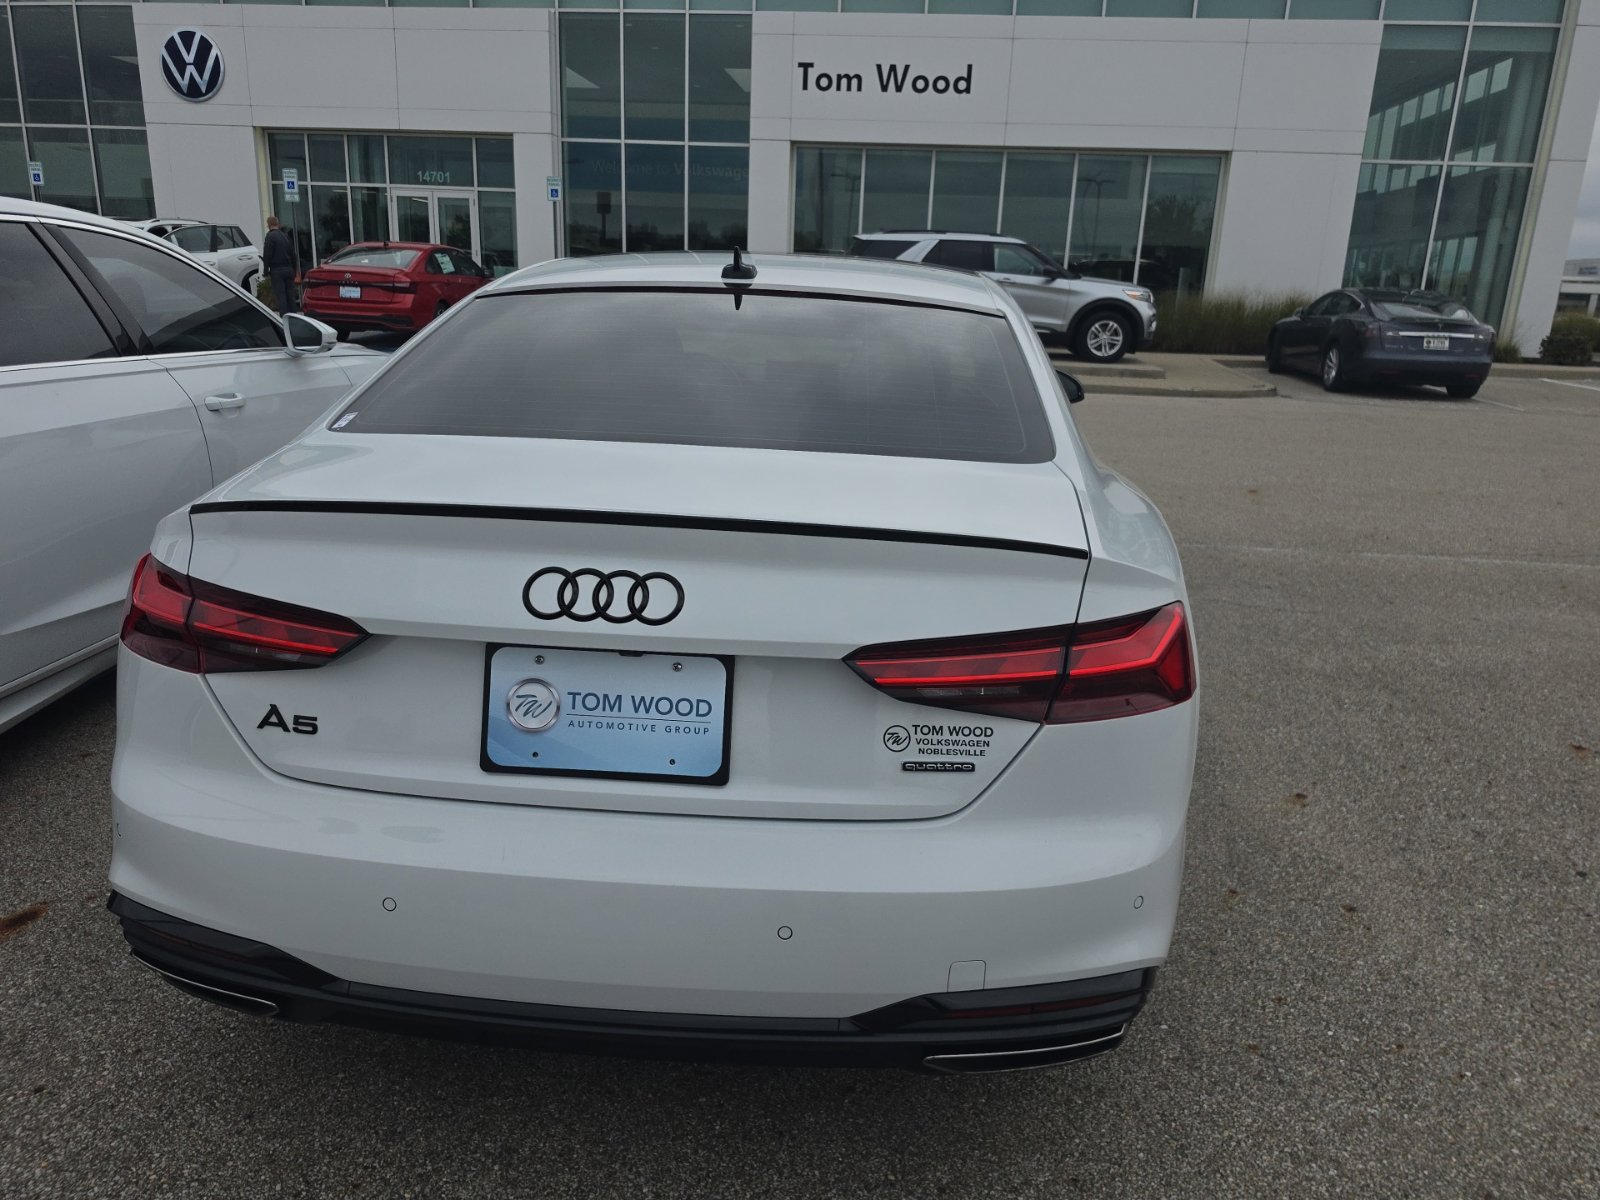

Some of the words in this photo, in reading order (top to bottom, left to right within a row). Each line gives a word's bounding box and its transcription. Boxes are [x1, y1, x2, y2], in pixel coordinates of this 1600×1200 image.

[797, 62, 863, 92] Tom
[875, 63, 973, 94] Wood
[416, 170, 451, 183] 14701
[566, 691, 623, 713] TOM
[630, 695, 713, 718] WOOD
[256, 703, 319, 735] A5
[567, 719, 657, 733] AUTOMOTIVE
[664, 725, 710, 735] GROUP
[911, 724, 944, 736] TOM
[947, 725, 994, 738] WOOD
[915, 738, 991, 748] VOLKSWAGEN
[918, 747, 986, 757] NOBLESVILLE
[904, 763, 974, 771] quattro
